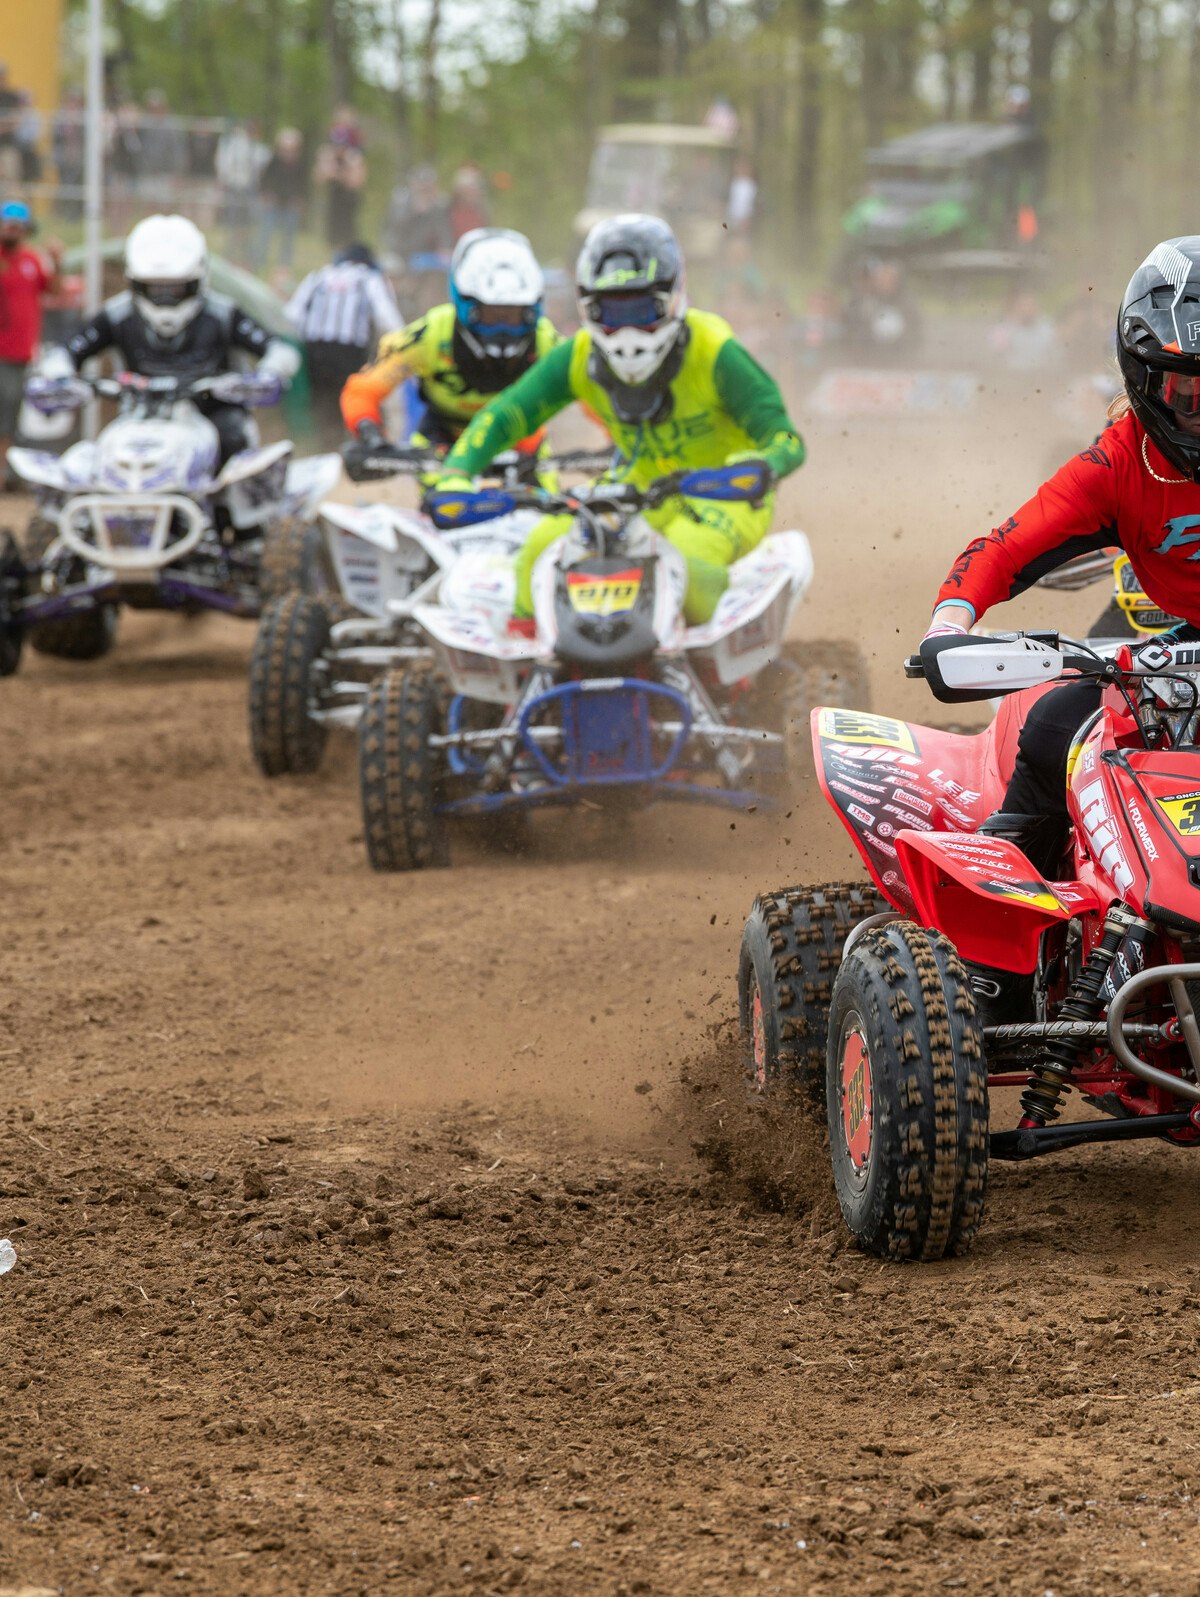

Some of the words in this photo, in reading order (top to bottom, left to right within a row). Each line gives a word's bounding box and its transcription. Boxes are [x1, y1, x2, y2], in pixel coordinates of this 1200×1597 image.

[927, 768, 981, 804] LEE
[852, 806, 871, 821] TMS
[882, 803, 934, 830] BALDWIN
[1130, 807, 1160, 862] FOURWERX
[962, 853, 1013, 871] ROCKET
[1117, 951, 1132, 980] AXI
[996, 1020, 1108, 1038] WALSH
